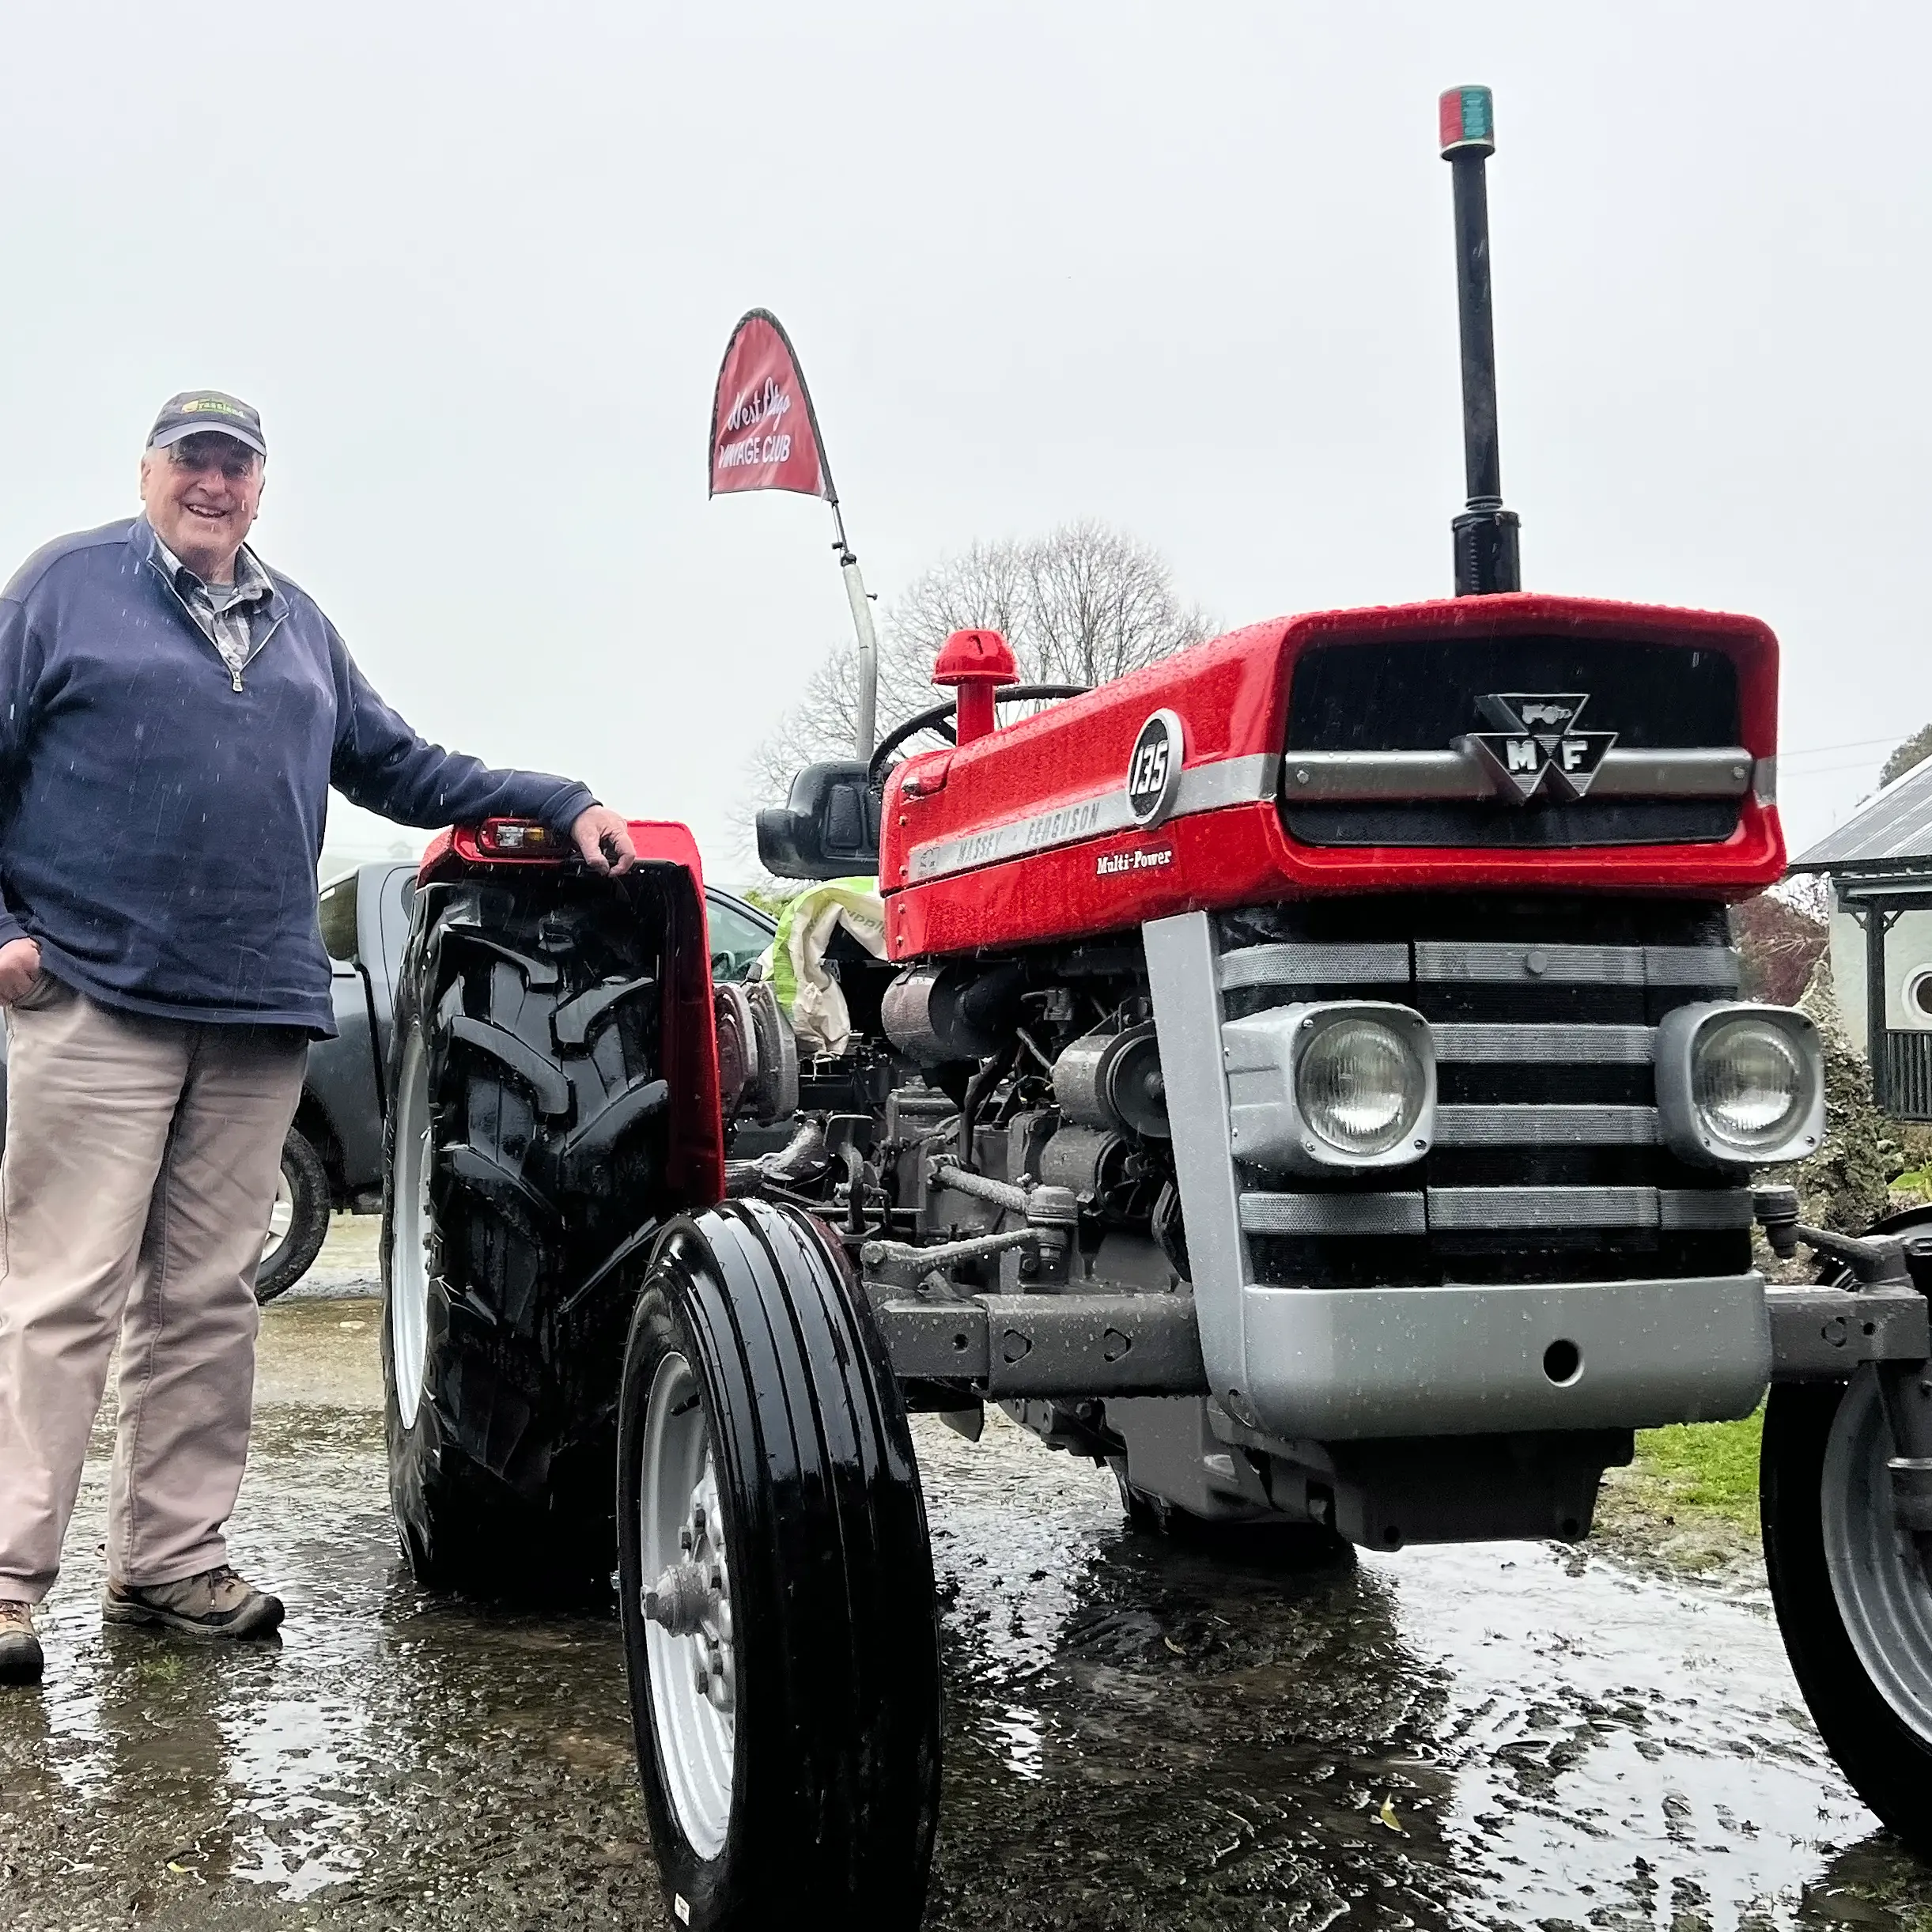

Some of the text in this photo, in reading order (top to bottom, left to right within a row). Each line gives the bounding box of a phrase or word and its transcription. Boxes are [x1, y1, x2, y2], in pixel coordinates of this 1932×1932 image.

[762, 434, 791, 463] CLUB
[1130, 742, 1169, 795] 135
[957, 802, 1101, 864] MASSEY FERGUSON
[1097, 849, 1172, 875] Multi-Power
